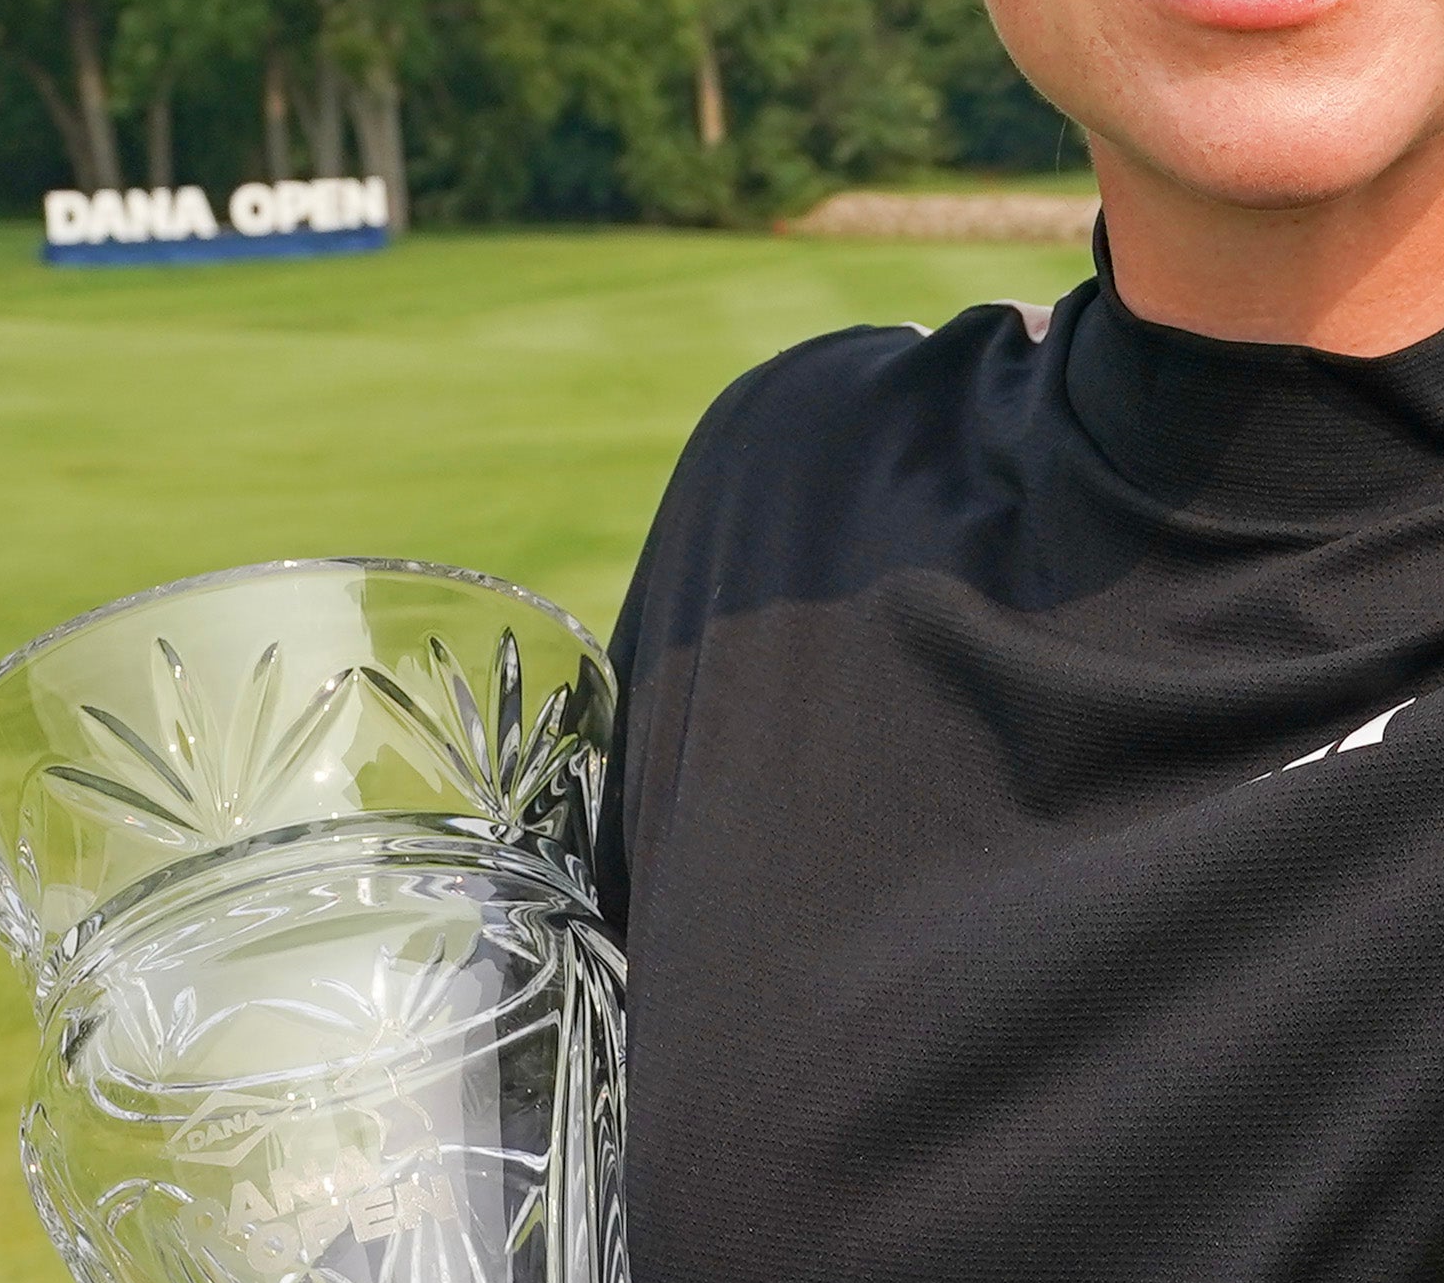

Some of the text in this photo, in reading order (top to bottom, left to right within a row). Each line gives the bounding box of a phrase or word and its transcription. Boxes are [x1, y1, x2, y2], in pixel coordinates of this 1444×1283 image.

[44, 175, 388, 245] DANA OPEN
[186, 1109, 265, 1152] DANA
[177, 1145, 380, 1250] DANA
[246, 1173, 459, 1274] OPEN
